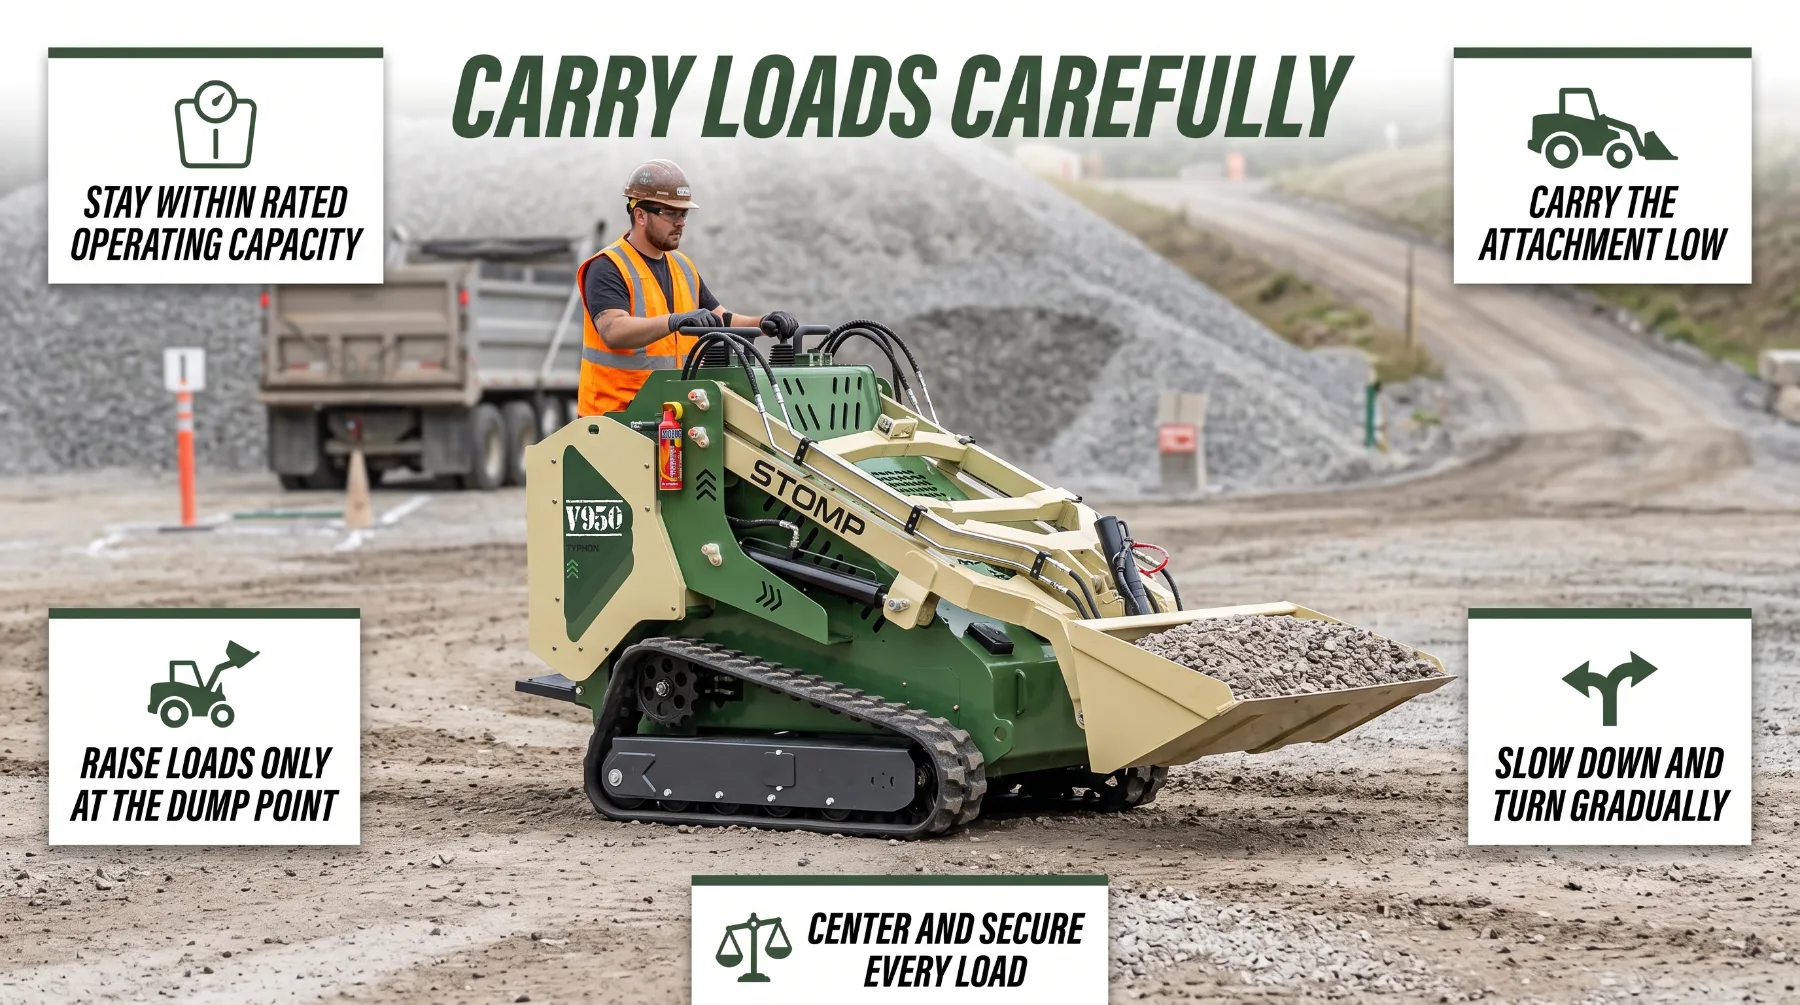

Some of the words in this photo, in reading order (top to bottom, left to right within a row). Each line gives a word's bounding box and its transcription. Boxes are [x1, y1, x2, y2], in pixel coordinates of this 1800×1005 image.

[750, 459, 866, 536] STOMP
[565, 505, 623, 531] V950
[566, 544, 599, 552] TYPHON
